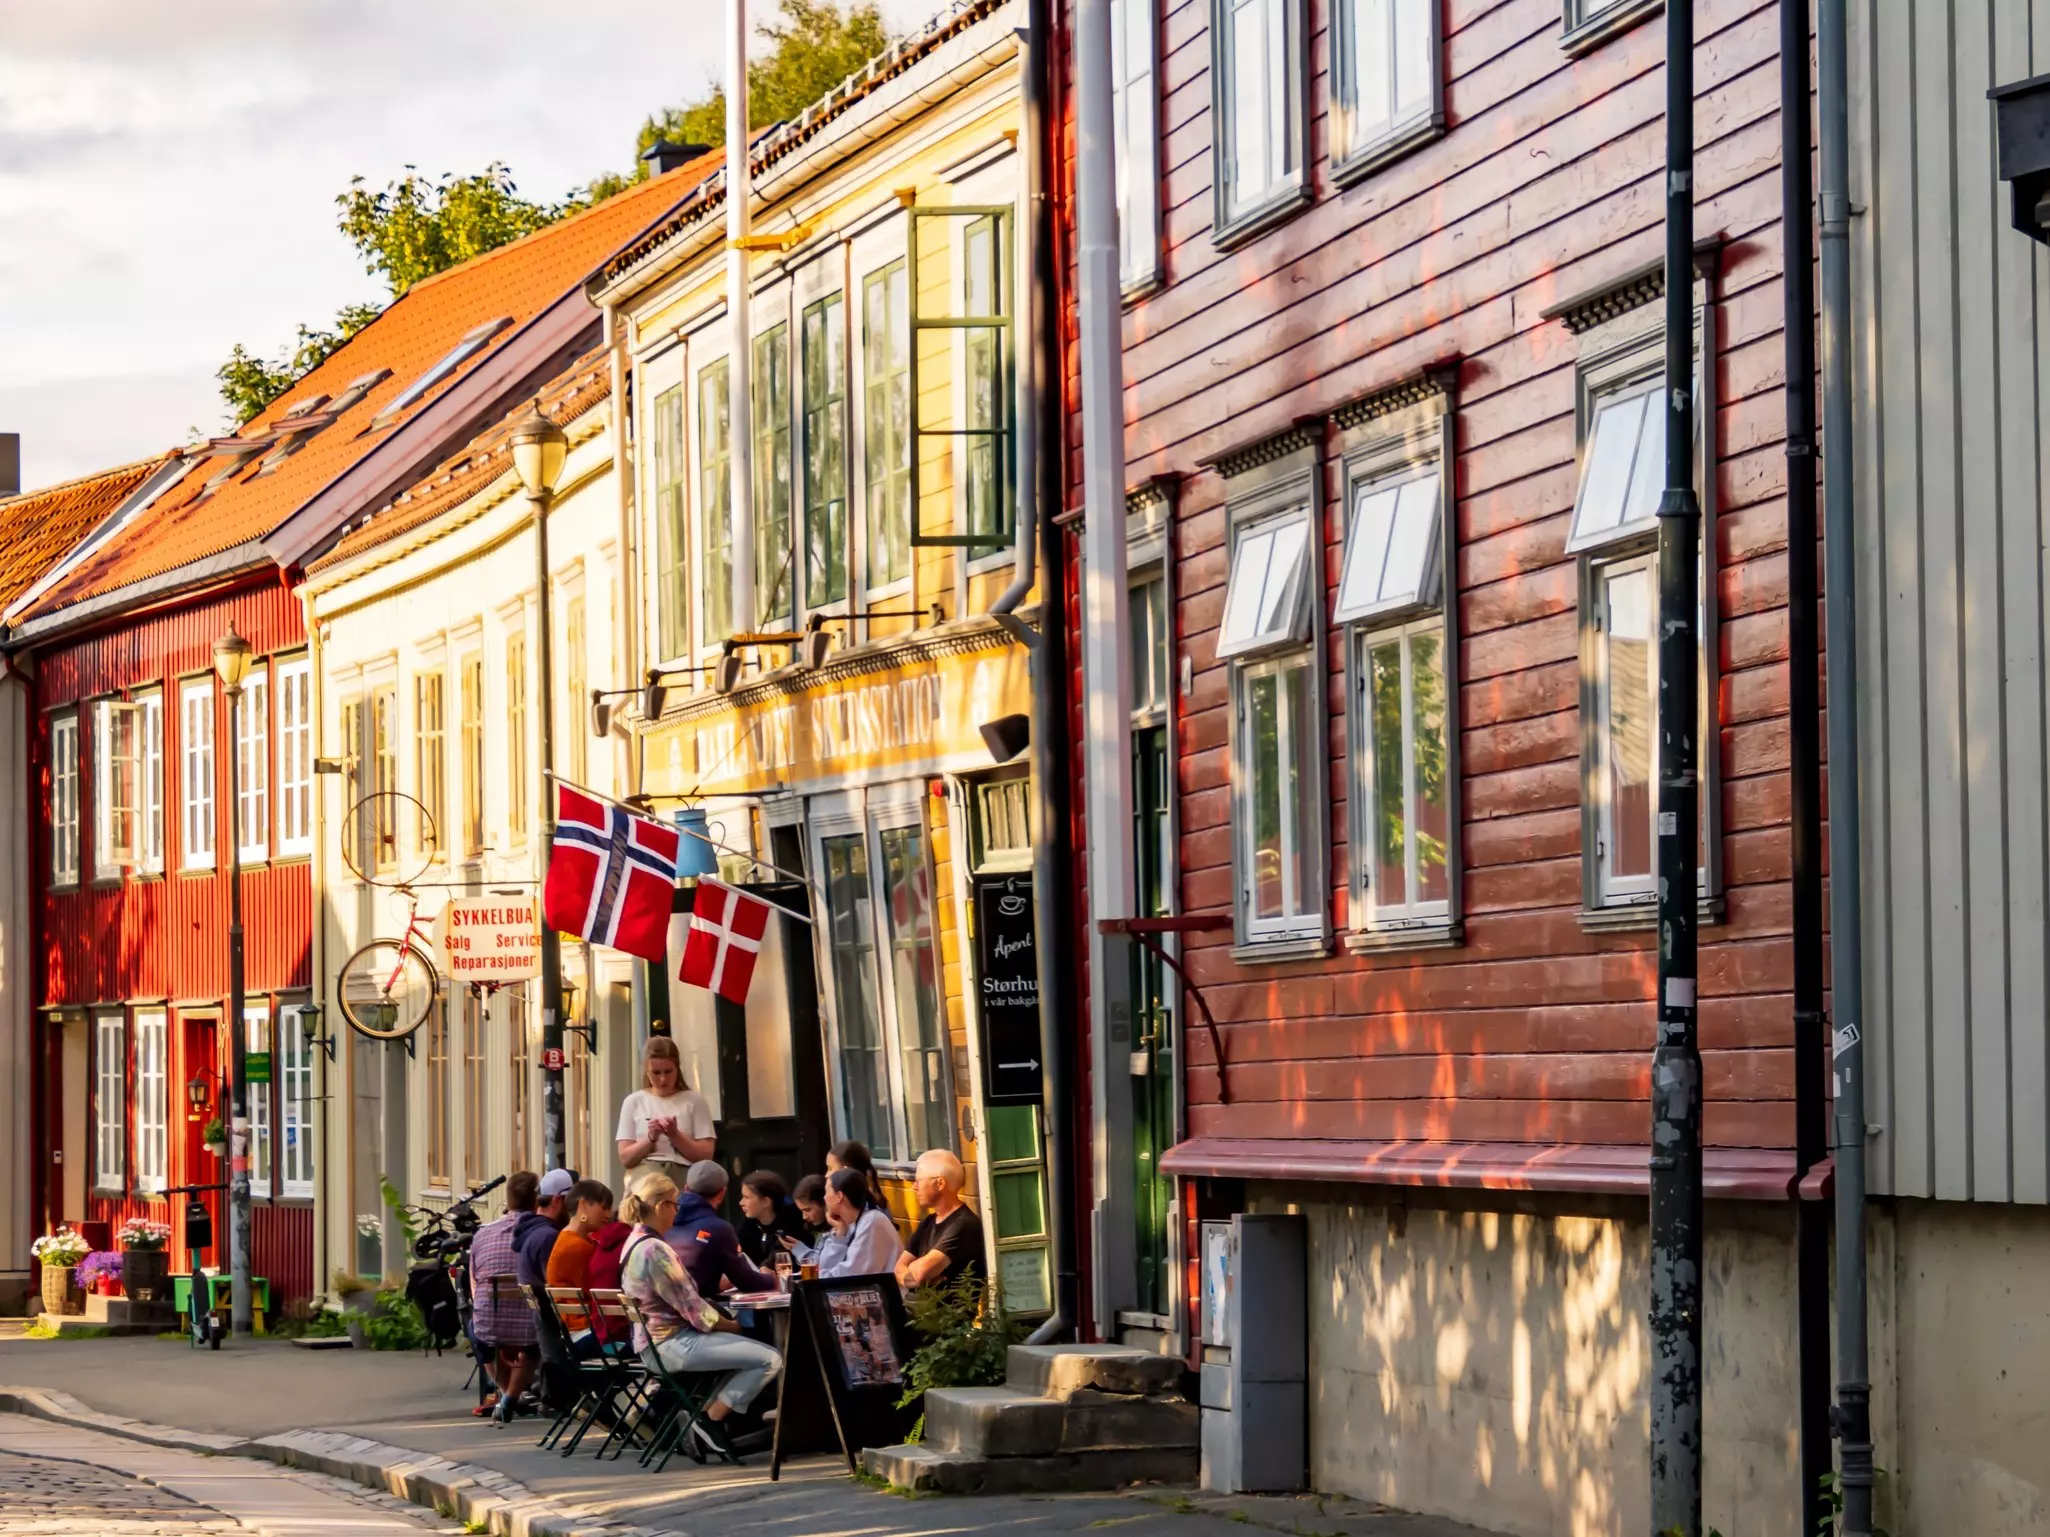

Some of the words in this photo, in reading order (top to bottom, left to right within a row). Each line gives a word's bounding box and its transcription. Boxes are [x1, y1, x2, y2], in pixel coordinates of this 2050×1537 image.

[453, 907, 534, 927] SYKKELBUA
[445, 935, 471, 951] Salg
[496, 933, 543, 948] Service
[993, 932, 1033, 959] Åpent
[453, 954, 537, 971] Reparasjoner
[990, 996, 1006, 1007] vår
